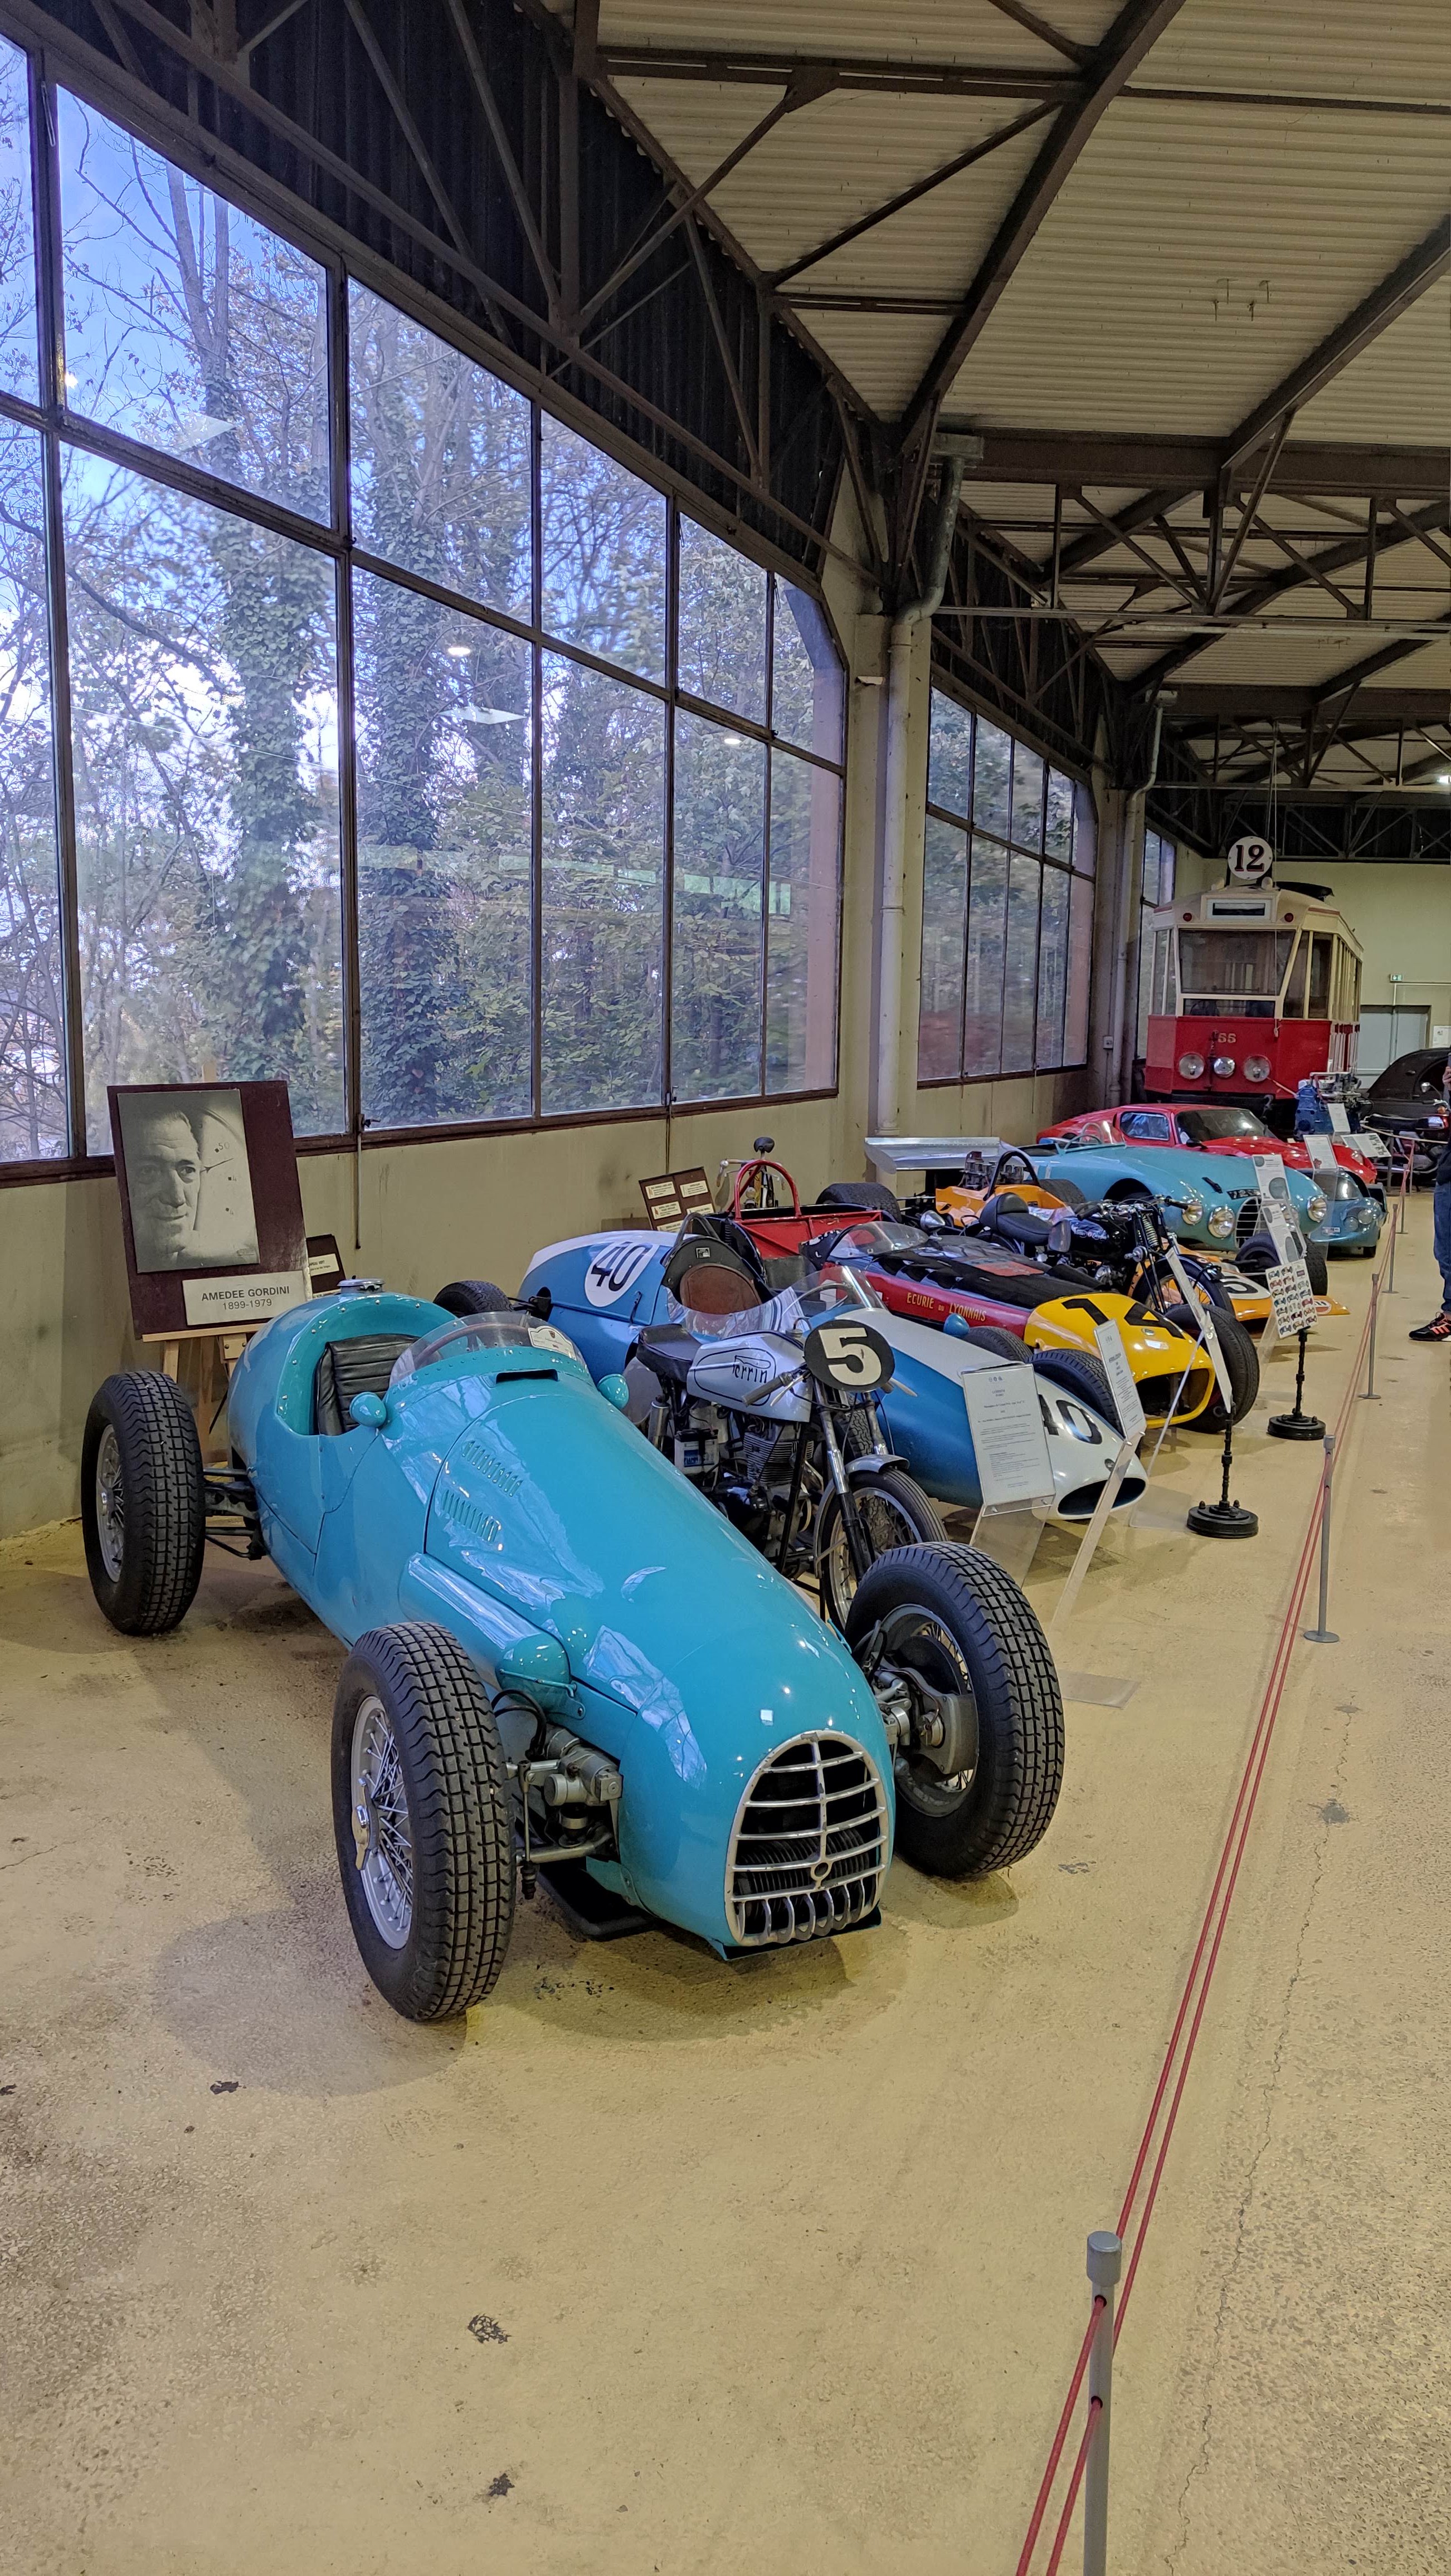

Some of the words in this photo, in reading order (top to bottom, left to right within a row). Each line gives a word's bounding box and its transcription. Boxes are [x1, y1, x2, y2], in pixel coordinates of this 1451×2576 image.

[1234, 845, 1264, 872] 12
[591, 1241, 653, 1292] 40
[201, 1290, 245, 1301] AMEDEE
[247, 1286, 290, 1297] GORDINI
[222, 1298, 272, 1310] 1899-1979
[907, 1292, 934, 1309] ECURIE
[949, 1302, 987, 1322] LYONNAIS
[1061, 1298, 1186, 1340] 14
[818, 1327, 882, 1386] 5
